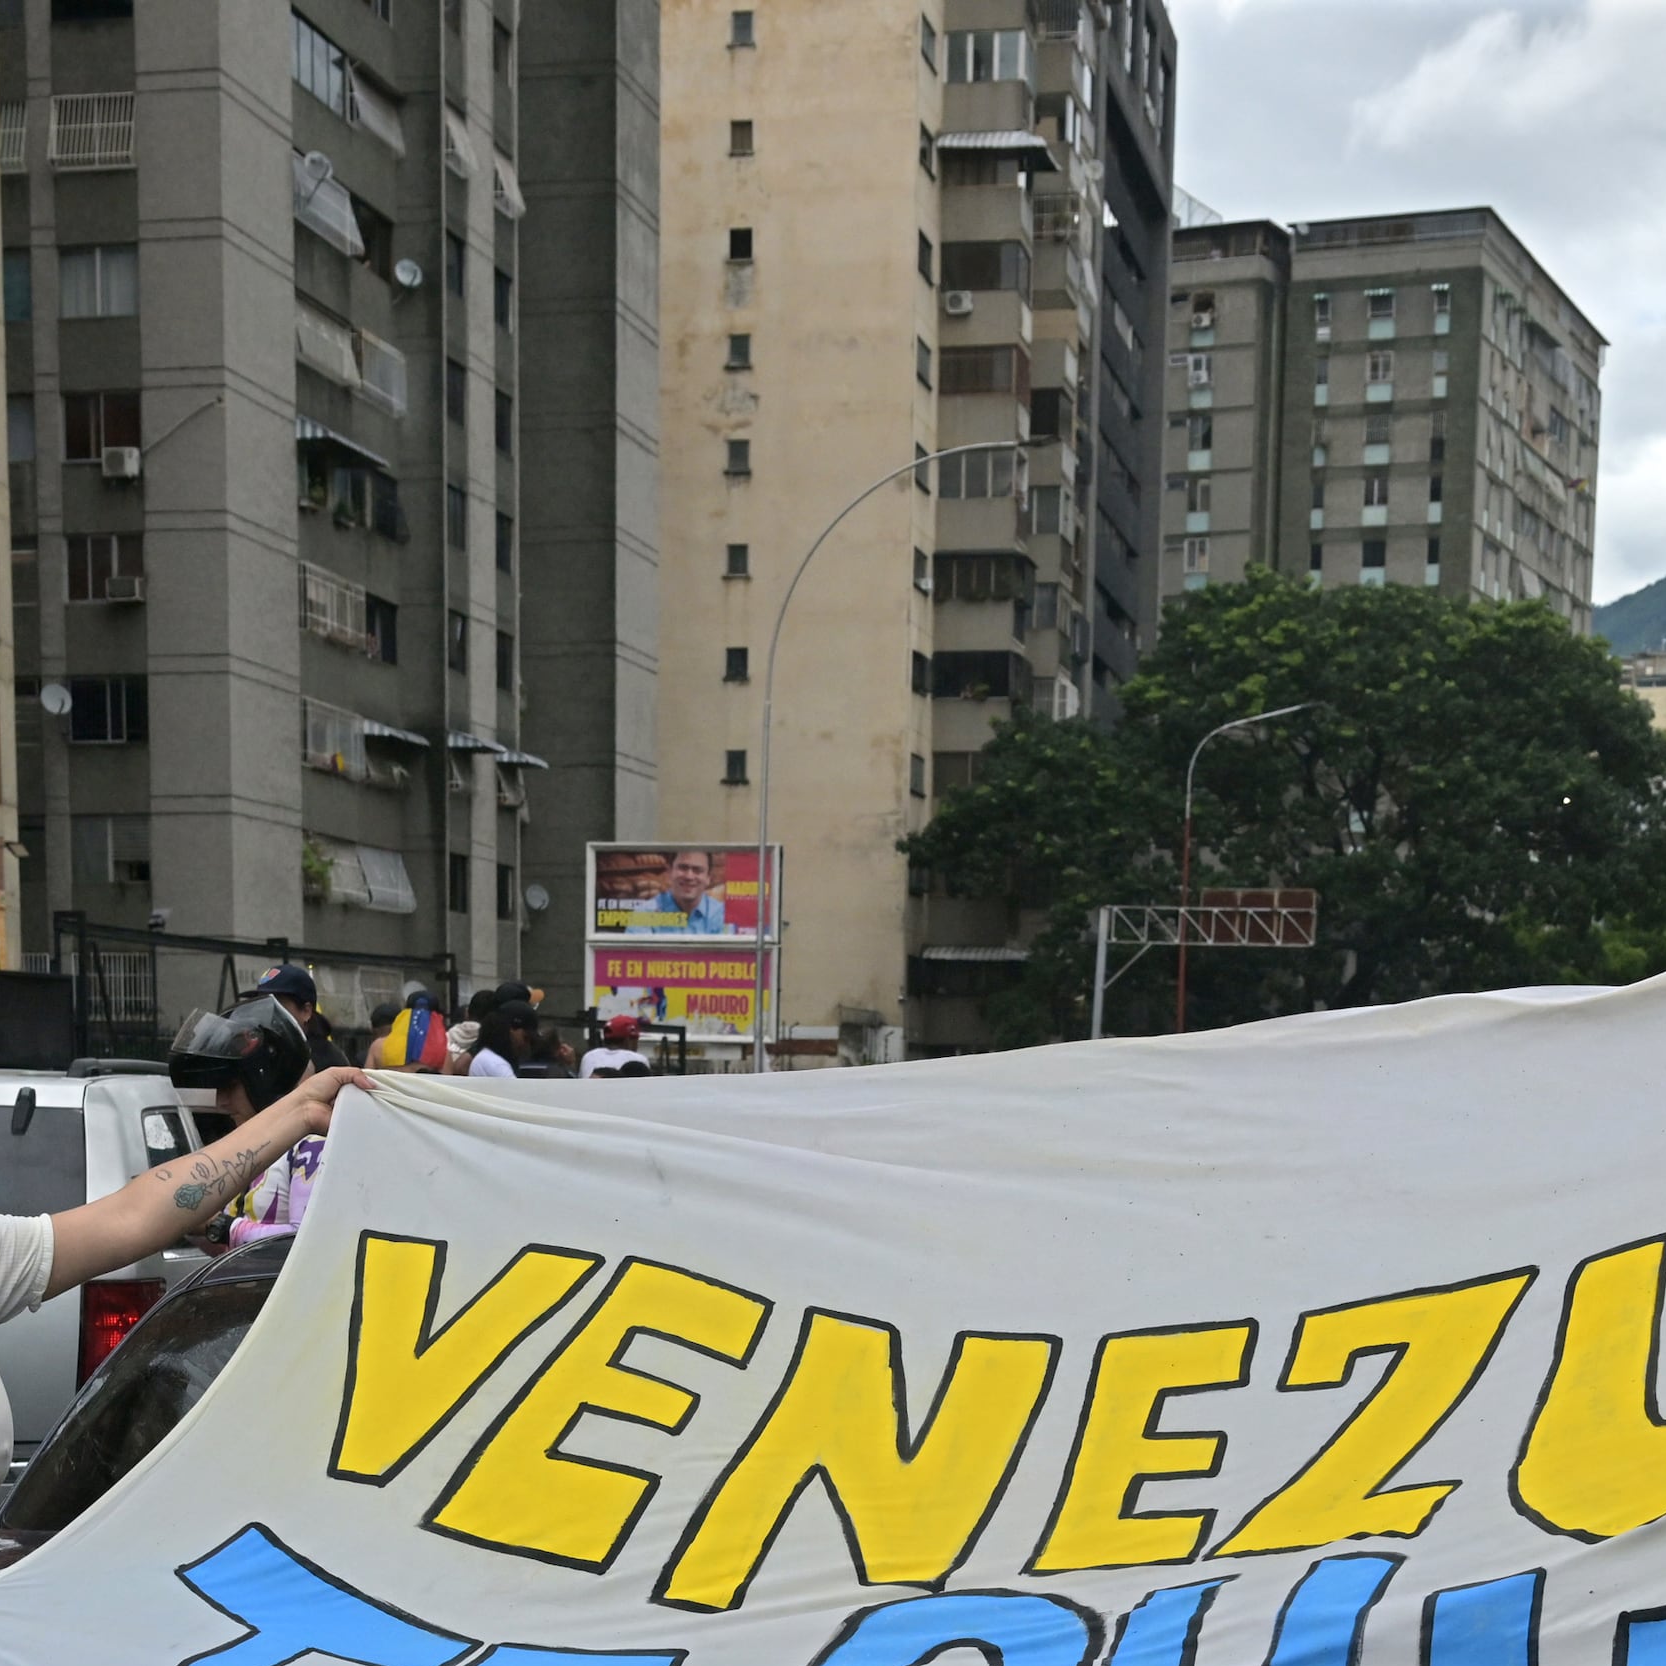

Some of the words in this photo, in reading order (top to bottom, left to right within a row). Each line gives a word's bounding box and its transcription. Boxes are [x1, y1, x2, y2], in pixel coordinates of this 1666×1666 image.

[607, 960, 622, 978] FE
[627, 960, 643, 978] EN
[647, 960, 707, 979] NUESTRO
[686, 993, 749, 1017] MADURO
